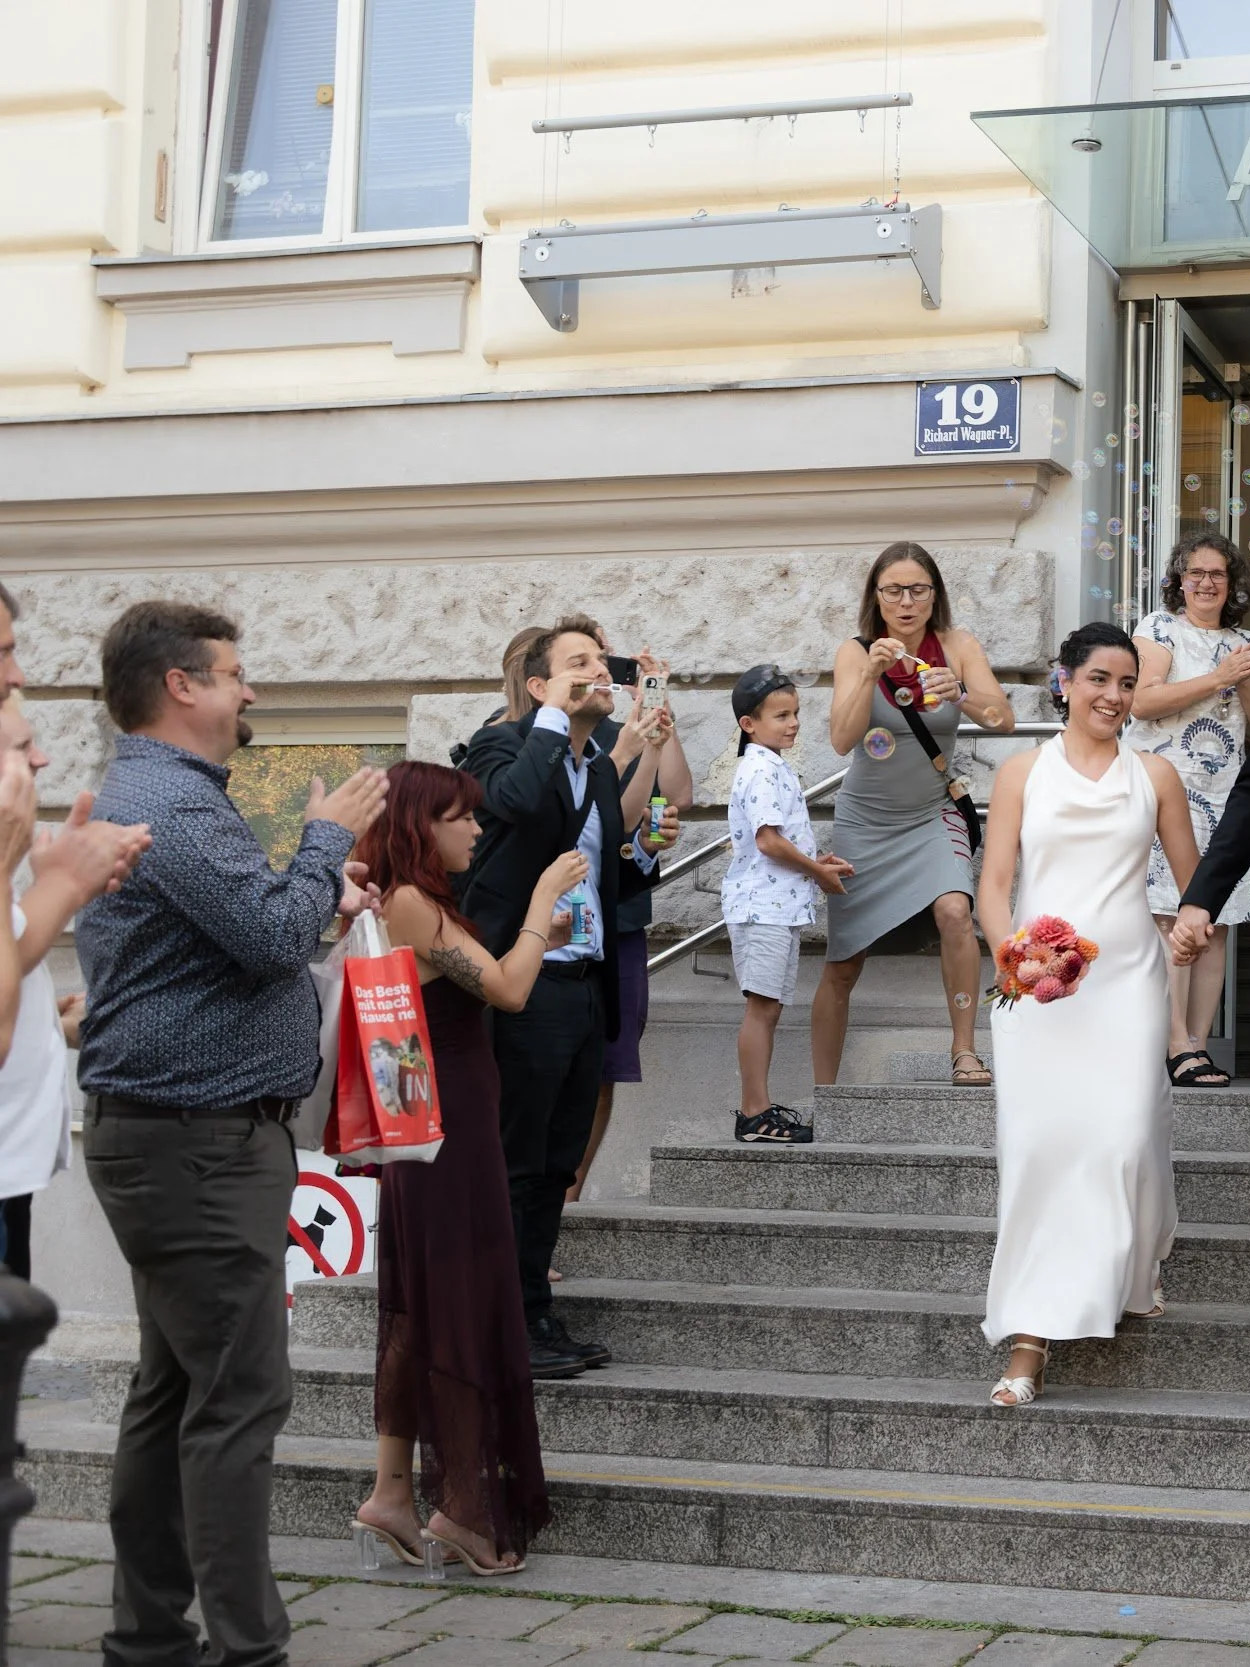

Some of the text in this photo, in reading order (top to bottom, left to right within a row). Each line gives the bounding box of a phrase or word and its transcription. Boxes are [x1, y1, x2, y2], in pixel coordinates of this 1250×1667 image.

[934, 383, 999, 426] 19
[924, 425, 1013, 443] Richard Wagner-Pl.
[355, 985, 373, 998] Das
[358, 995, 410, 1011] mit nach
[359, 1011, 395, 1024] Hause
